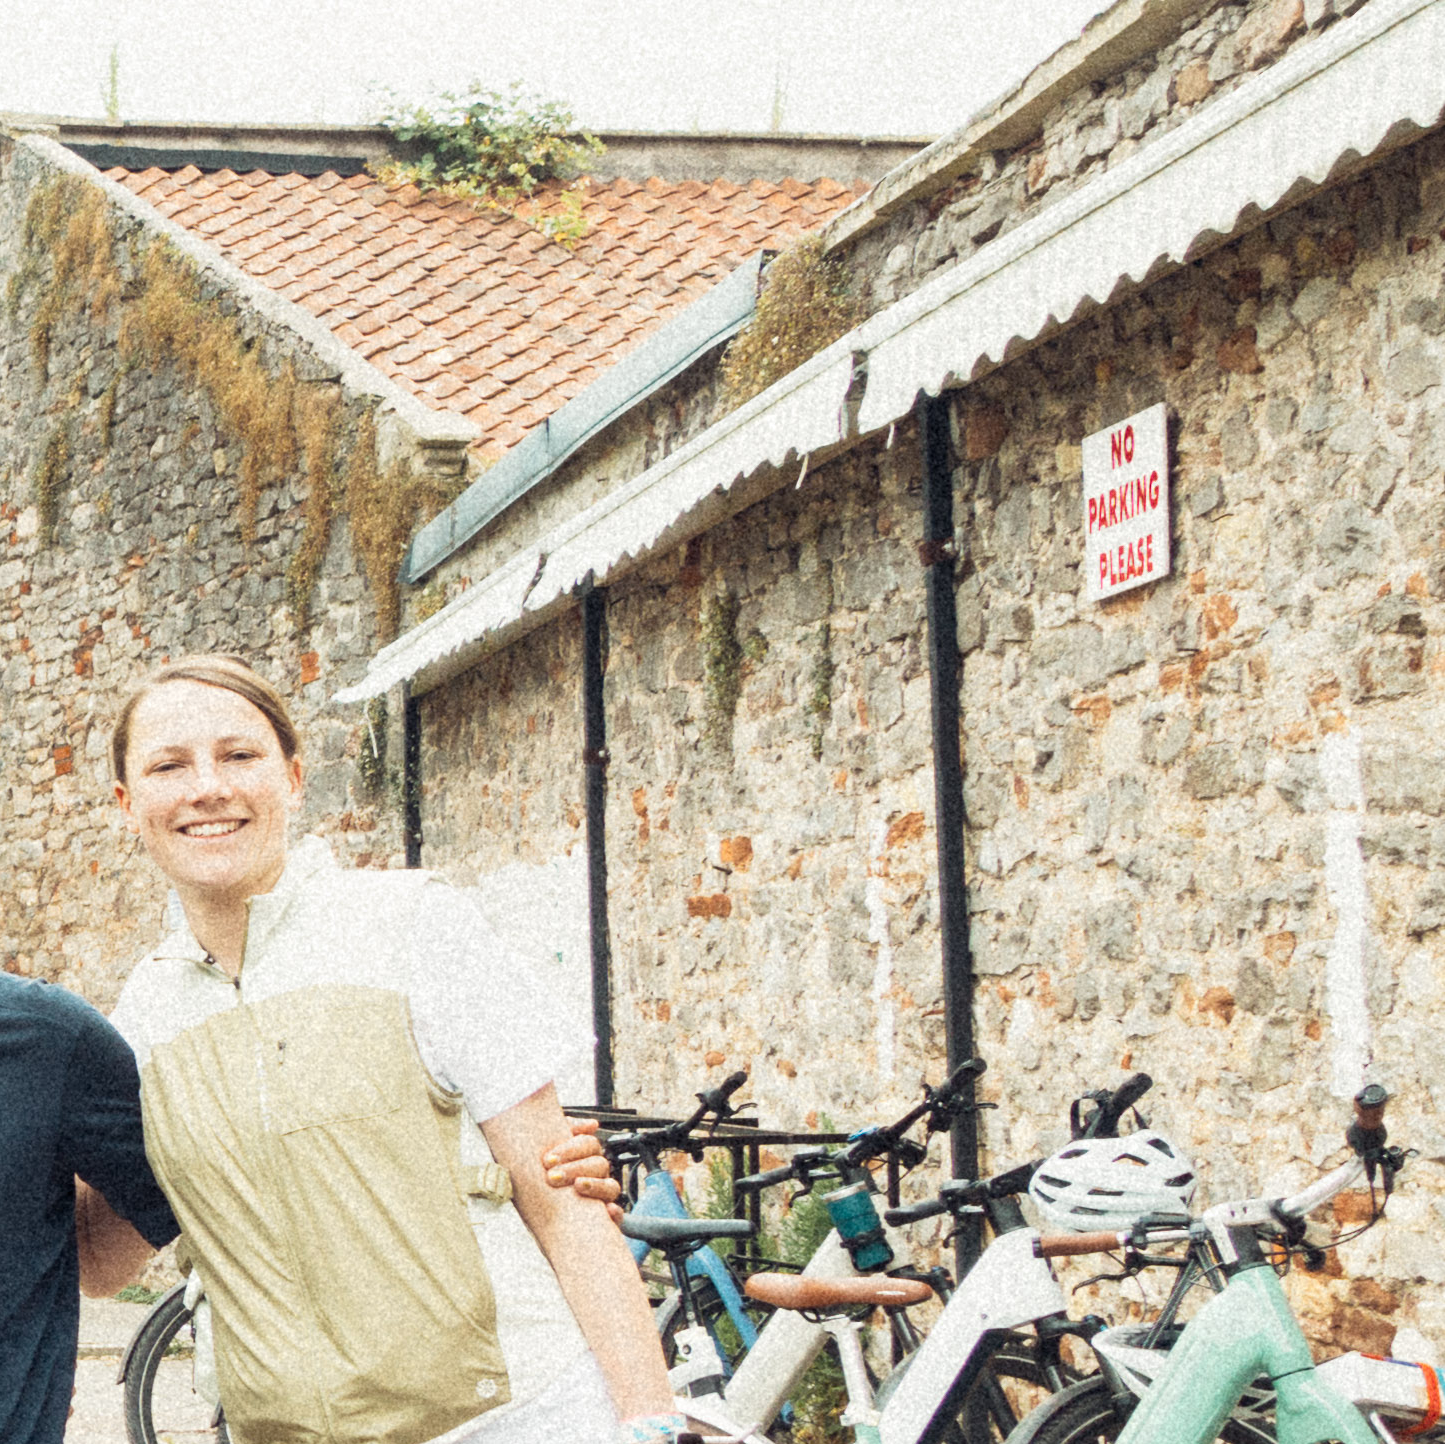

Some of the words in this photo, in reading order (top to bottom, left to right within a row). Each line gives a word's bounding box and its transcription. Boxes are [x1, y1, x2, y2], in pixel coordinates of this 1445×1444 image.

[1111, 425, 1134, 469] NO
[1088, 470, 1160, 534] PARKING
[1099, 534, 1154, 589] PLEASE
